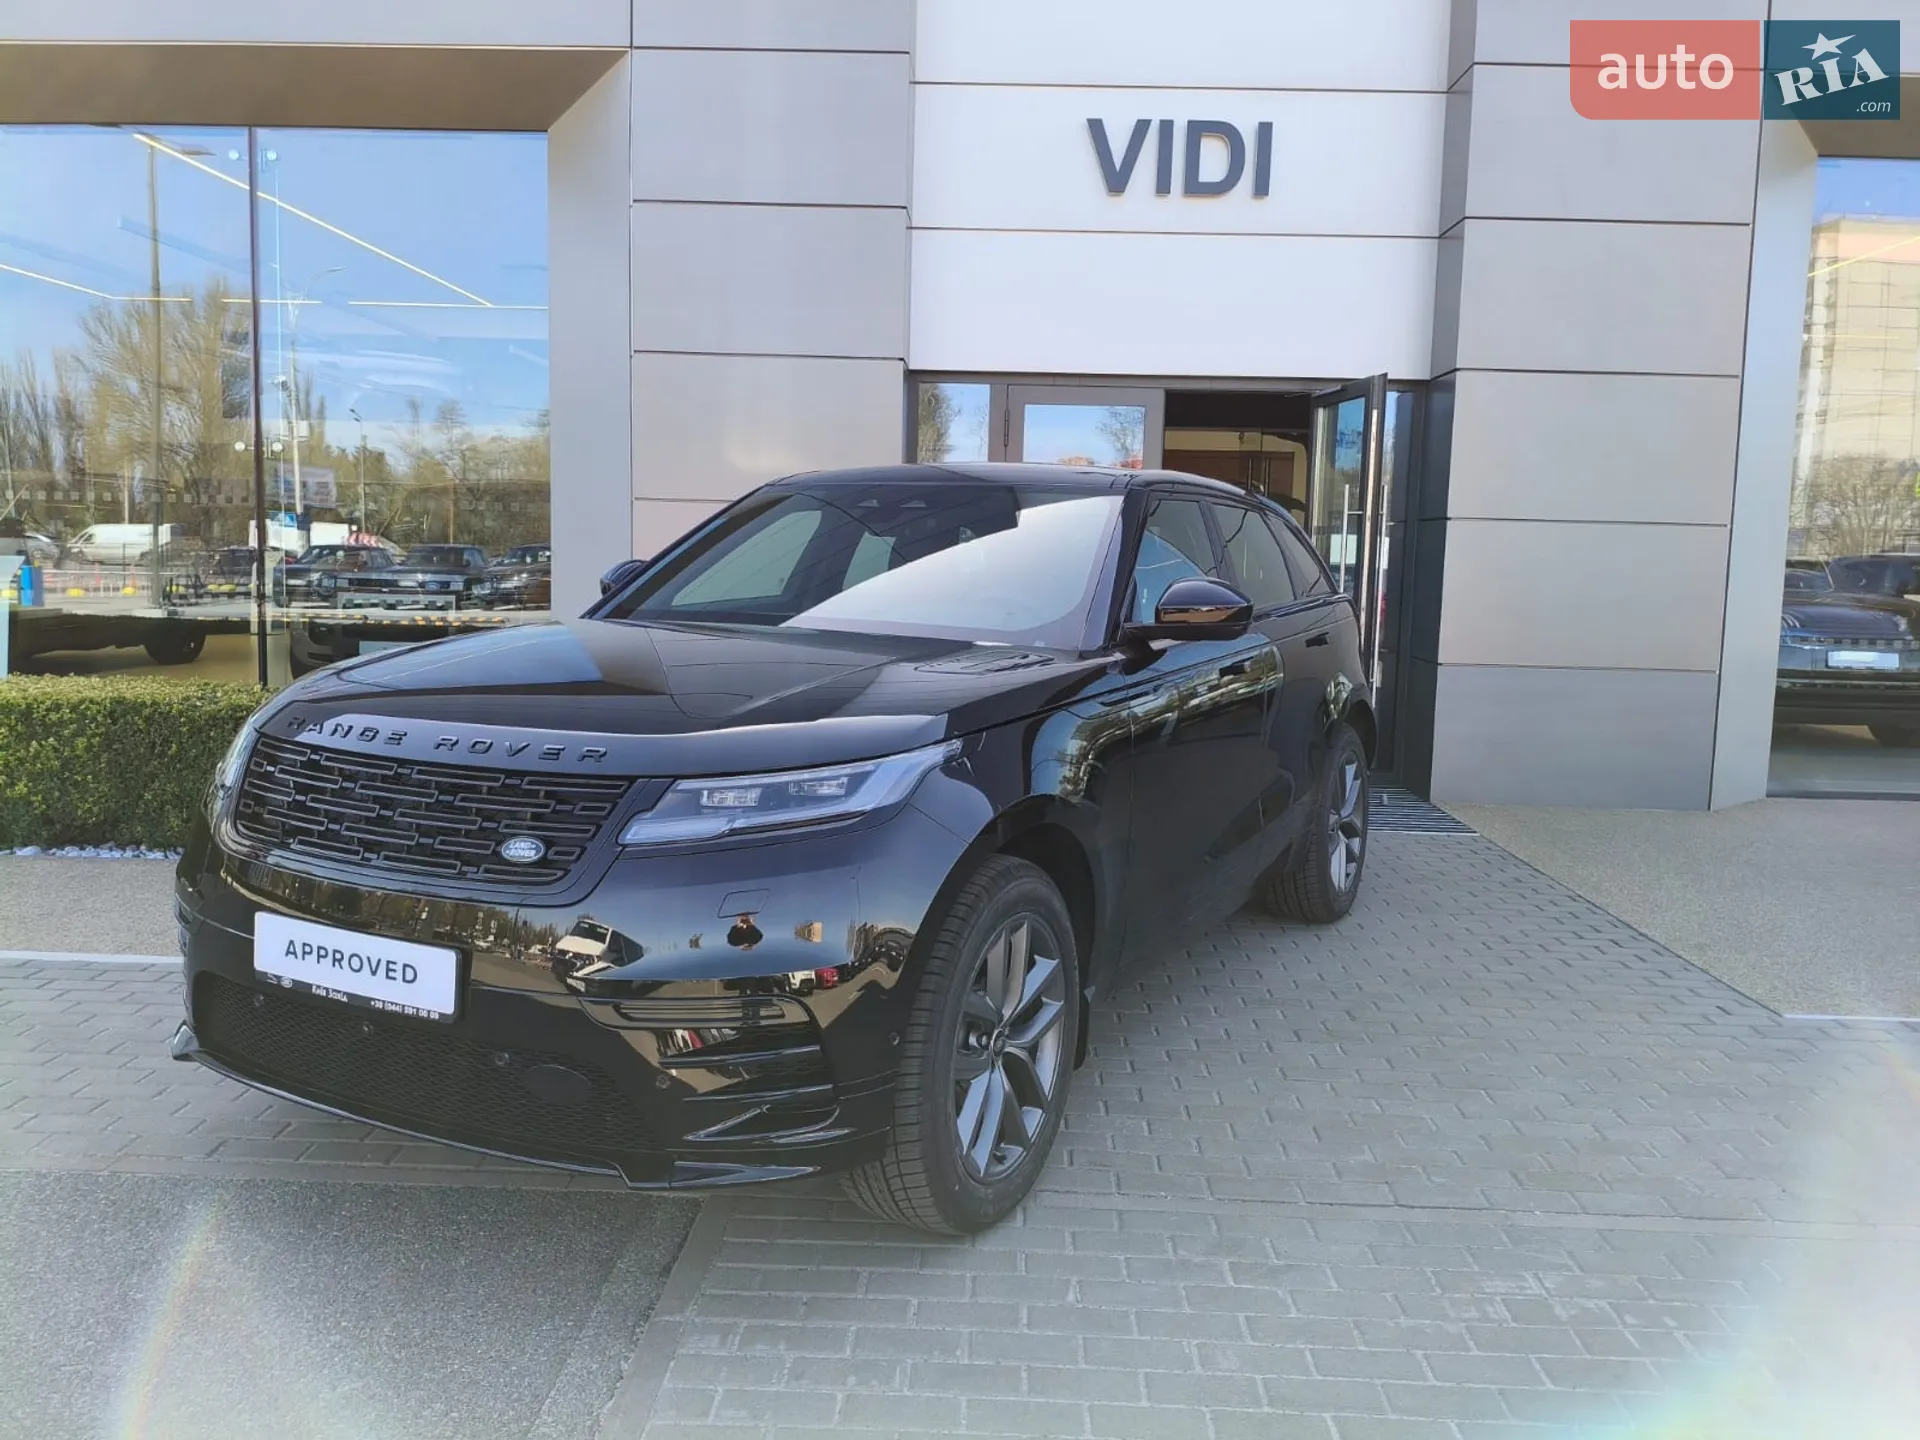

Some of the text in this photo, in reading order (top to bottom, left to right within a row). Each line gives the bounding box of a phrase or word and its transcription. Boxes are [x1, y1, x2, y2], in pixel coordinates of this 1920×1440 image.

[1086, 117, 1274, 197] VIDI
[287, 716, 608, 763] RANGE ROVER
[509, 849, 537, 857] ROVER
[284, 939, 418, 984] APPROVED
